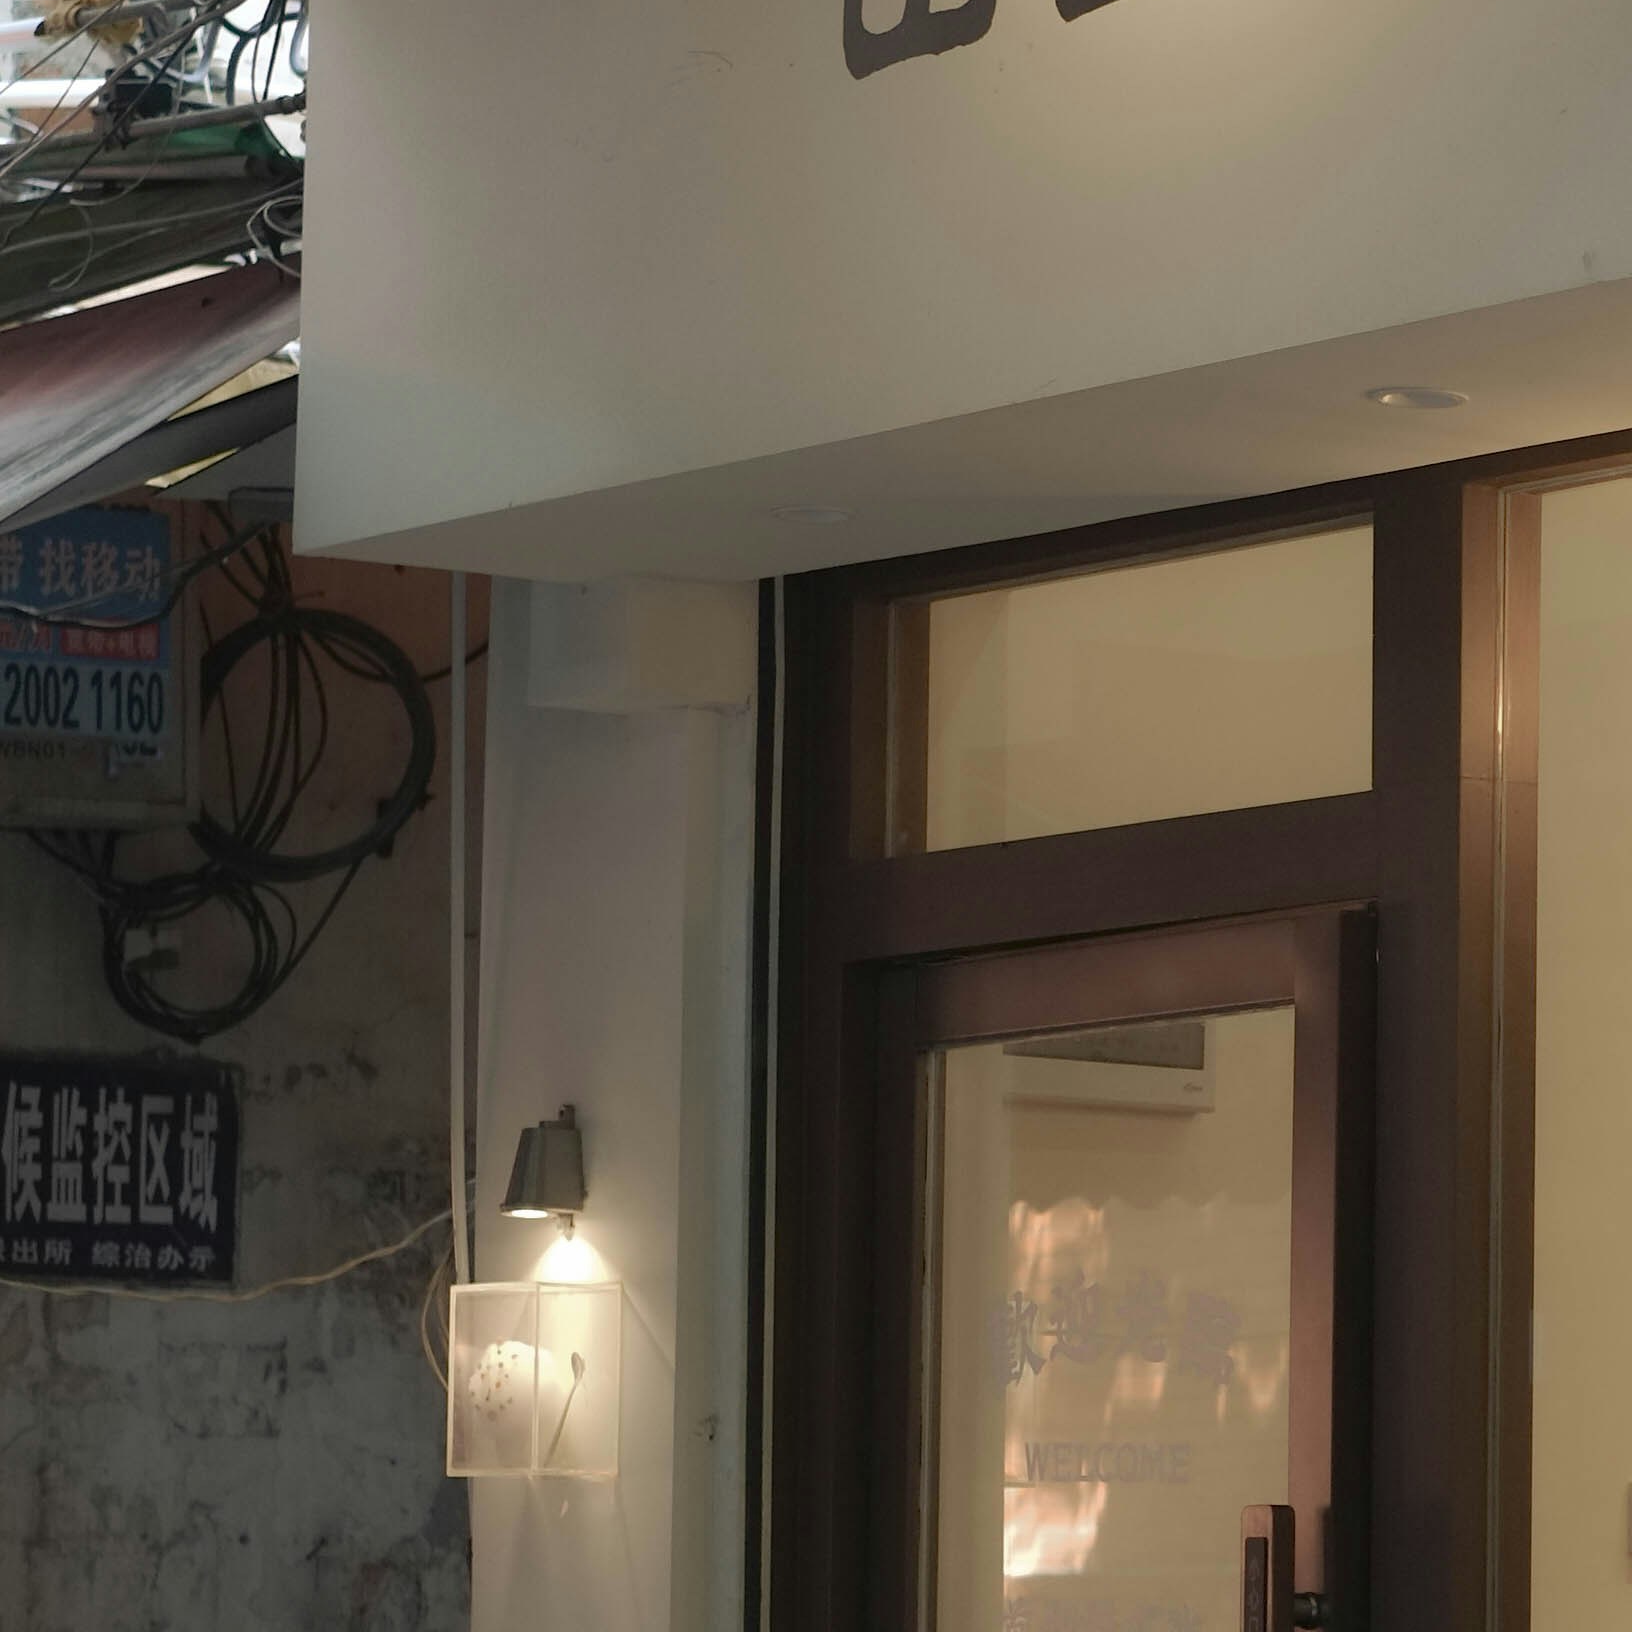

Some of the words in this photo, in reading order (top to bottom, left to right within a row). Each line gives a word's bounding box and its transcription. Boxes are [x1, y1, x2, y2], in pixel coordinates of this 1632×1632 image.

[40, 537, 161, 602] 找移动
[91, 670, 164, 734] 1160
[1, 1079, 219, 1234] 候监控区域
[1025, 1441, 1192, 1485] WELCOME
